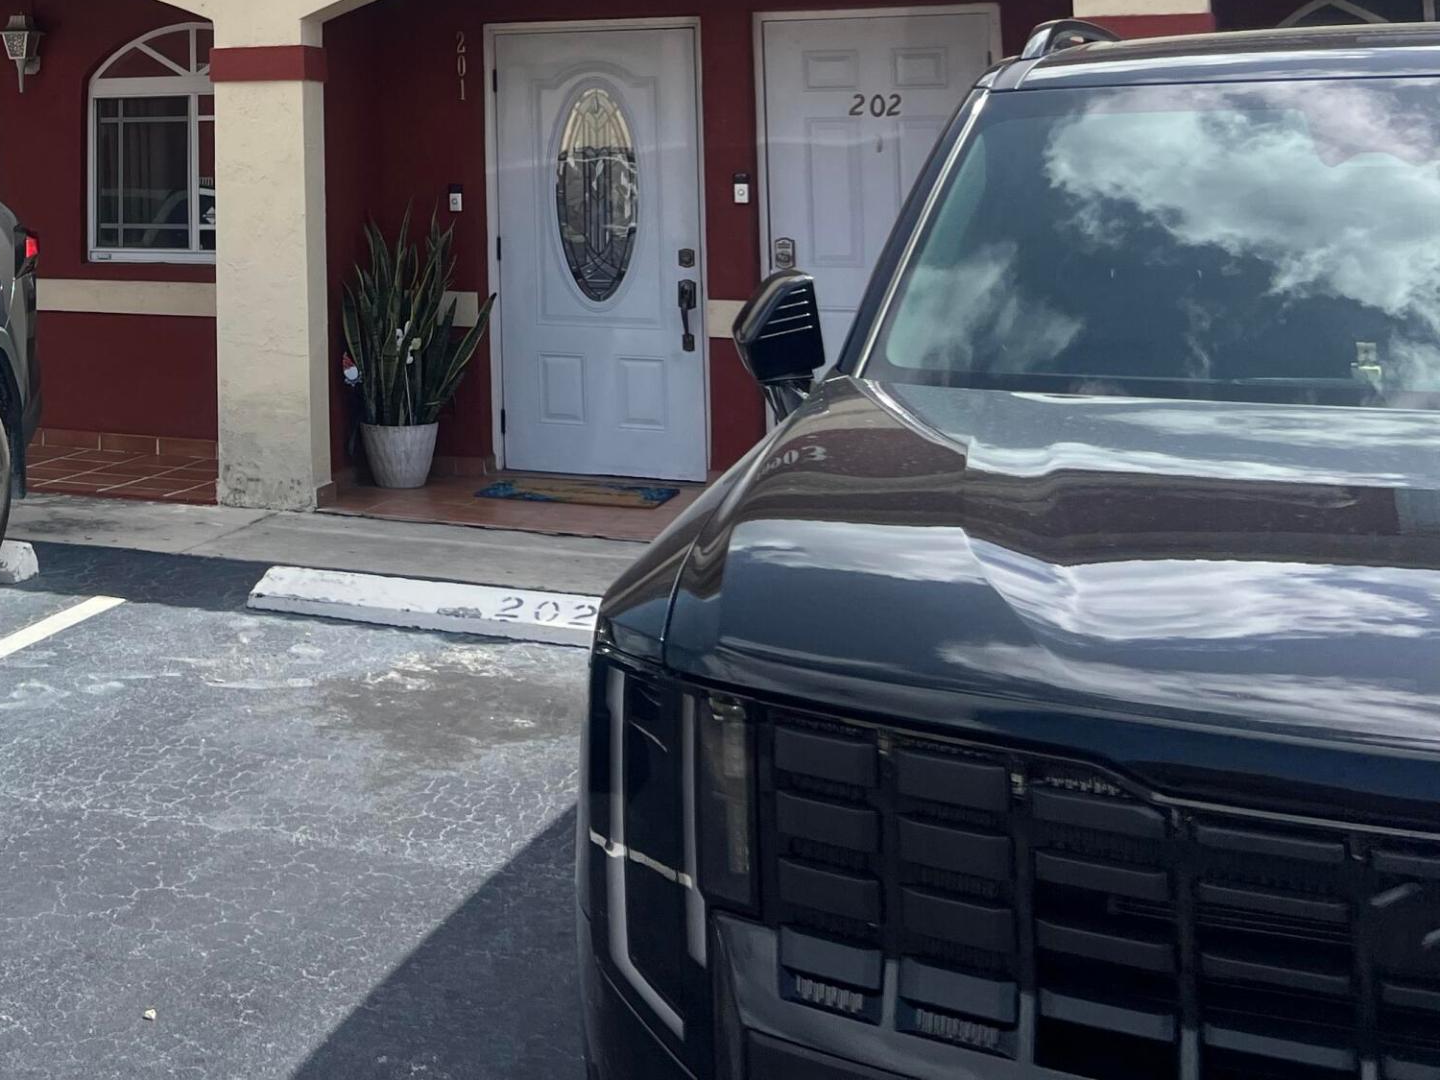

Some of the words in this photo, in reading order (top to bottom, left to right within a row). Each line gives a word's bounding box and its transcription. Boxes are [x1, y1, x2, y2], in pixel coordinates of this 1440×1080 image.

[456, 31, 466, 100] 201
[849, 93, 902, 118] 202
[494, 596, 598, 626] 202
